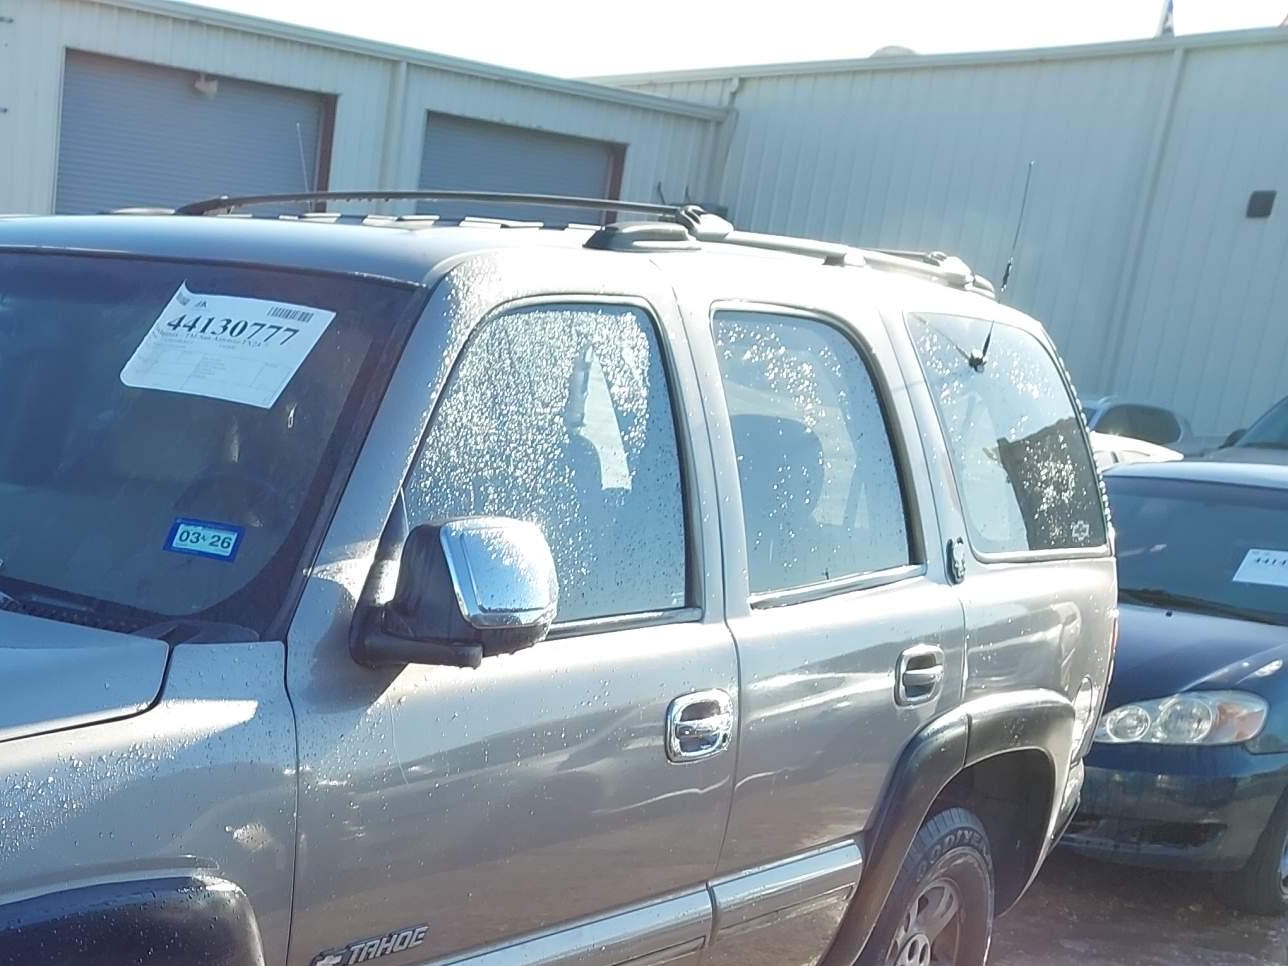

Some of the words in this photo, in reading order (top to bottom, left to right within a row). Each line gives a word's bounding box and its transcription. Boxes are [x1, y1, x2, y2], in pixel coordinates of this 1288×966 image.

[167, 314, 300, 345] 44130777
[178, 530, 201, 544] 03
[208, 534, 233, 549] 26
[347, 925, 430, 965] TAHOE
